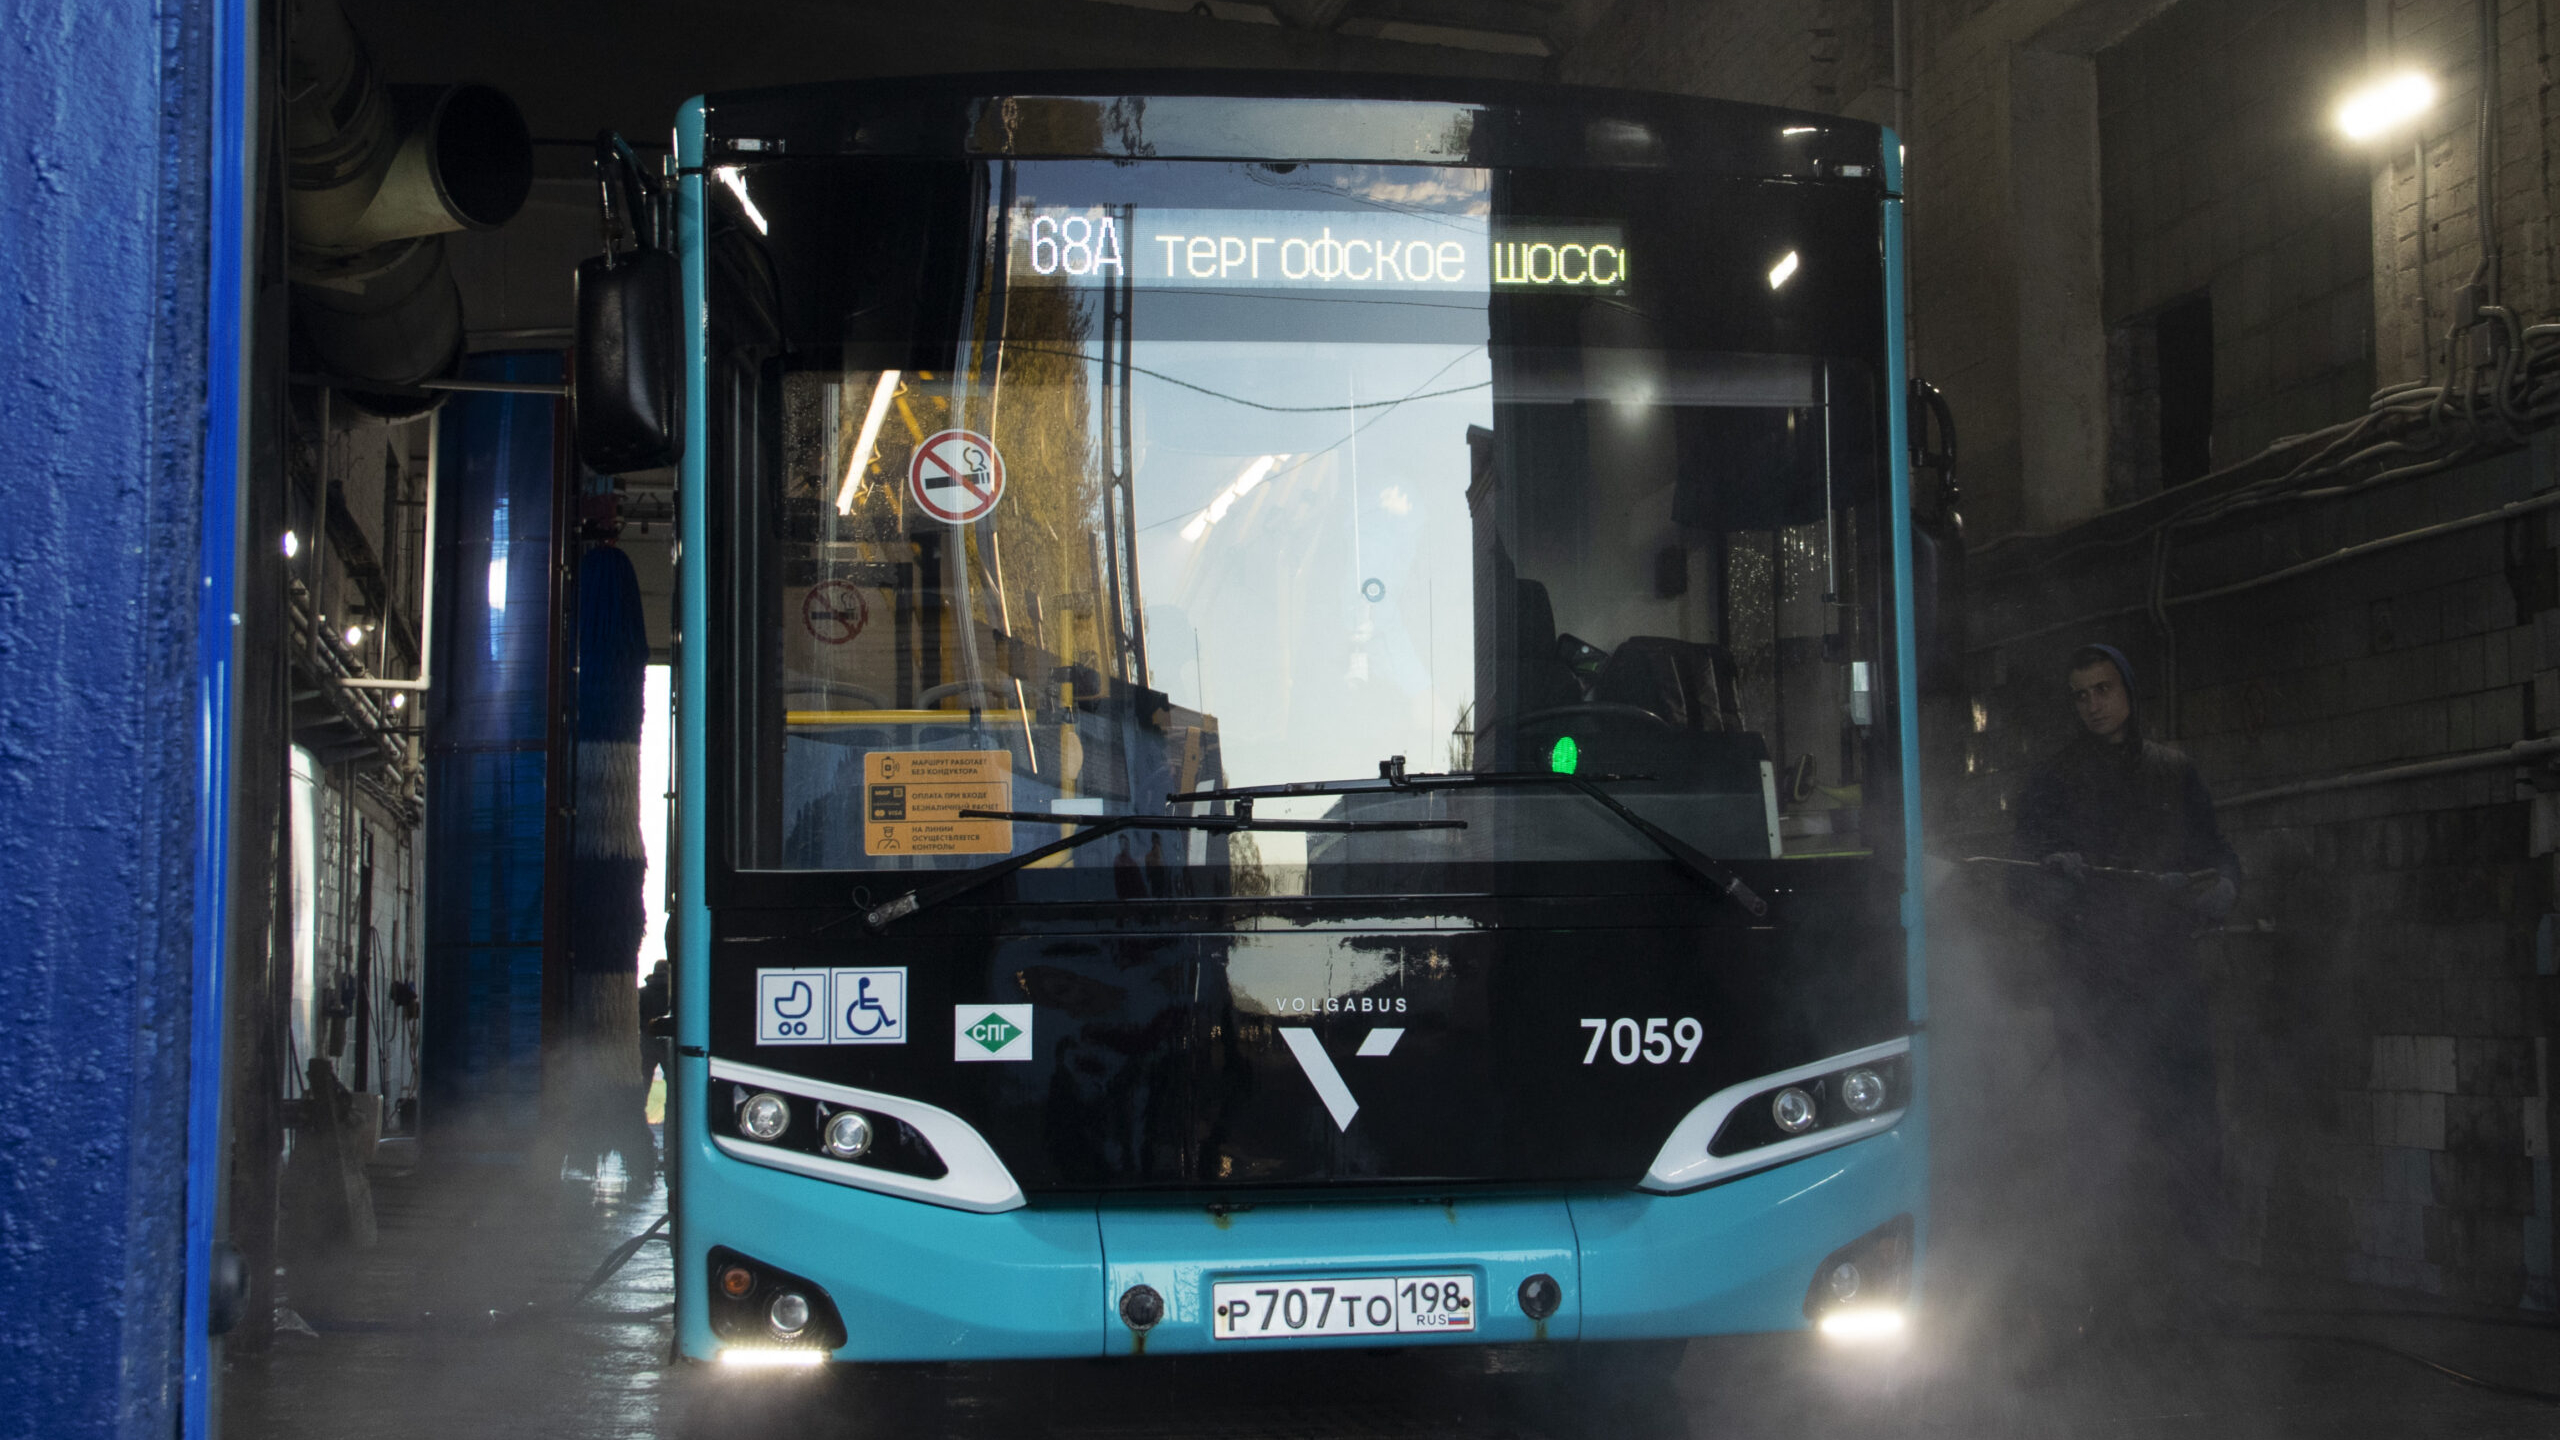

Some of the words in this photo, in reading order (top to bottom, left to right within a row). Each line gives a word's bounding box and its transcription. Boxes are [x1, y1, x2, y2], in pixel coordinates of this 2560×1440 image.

[1032, 215, 1124, 276] 68А
[911, 758, 949, 767] МАРШРУТ
[950, 757, 988, 766] РАБОТАЕТ
[911, 768, 925, 776] БЕЗ
[927, 768, 979, 776] КОНДУКТОРА
[911, 792, 943, 800] ОПЛАТА
[961, 791, 987, 799] ВХОДЕ
[911, 802, 970, 812] БЕЗНАЛИЧНЫЙ
[911, 825, 923, 833] НА
[924, 825, 954, 833] ЛИНИИ
[911, 834, 980, 842] ОСУЩЕСТВЛЯЕТСЯ
[1276, 997, 1407, 1013] VOLGABUS
[972, 1024, 1010, 1041] СПГ
[1580, 1017, 1703, 1065] 7059
[1400, 1281, 1461, 1314] 198
[1416, 1312, 1447, 1326] RUS
